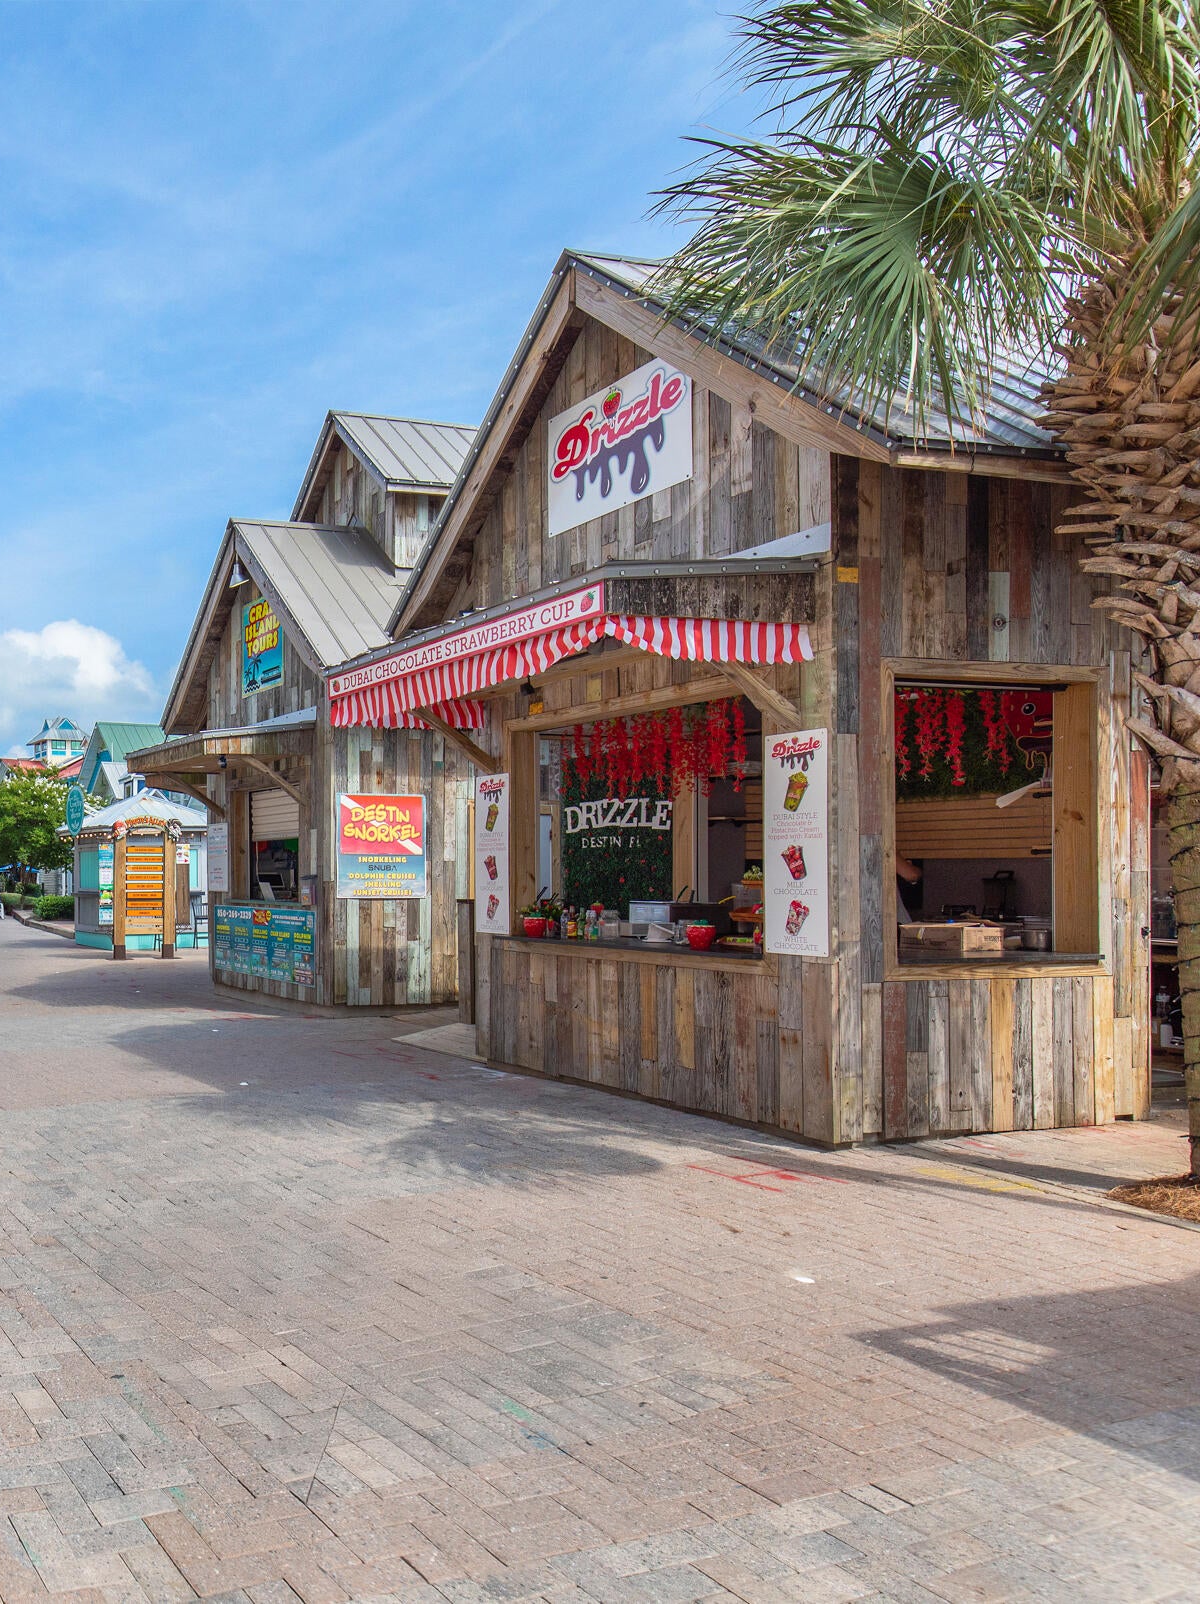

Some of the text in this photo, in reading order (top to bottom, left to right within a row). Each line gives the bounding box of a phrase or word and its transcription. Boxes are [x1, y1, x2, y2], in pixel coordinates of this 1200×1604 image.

[553, 373, 683, 478] Drizzle
[249, 601, 273, 624] CRA
[247, 631, 278, 658] TOURS
[343, 599, 575, 690] DUBAI CHOCOLATE STRAWBERRY CUP
[771, 736, 820, 758] Drizzle
[351, 804, 410, 823] DESTIN
[564, 798, 673, 834] DRIZZLE
[343, 823, 421, 842] SNORKEL
[581, 836, 622, 848] DESTIN
[368, 864, 398, 872] SNUBA
[774, 942, 819, 951] CHOCOLATE
[784, 935, 808, 943] WHITE
